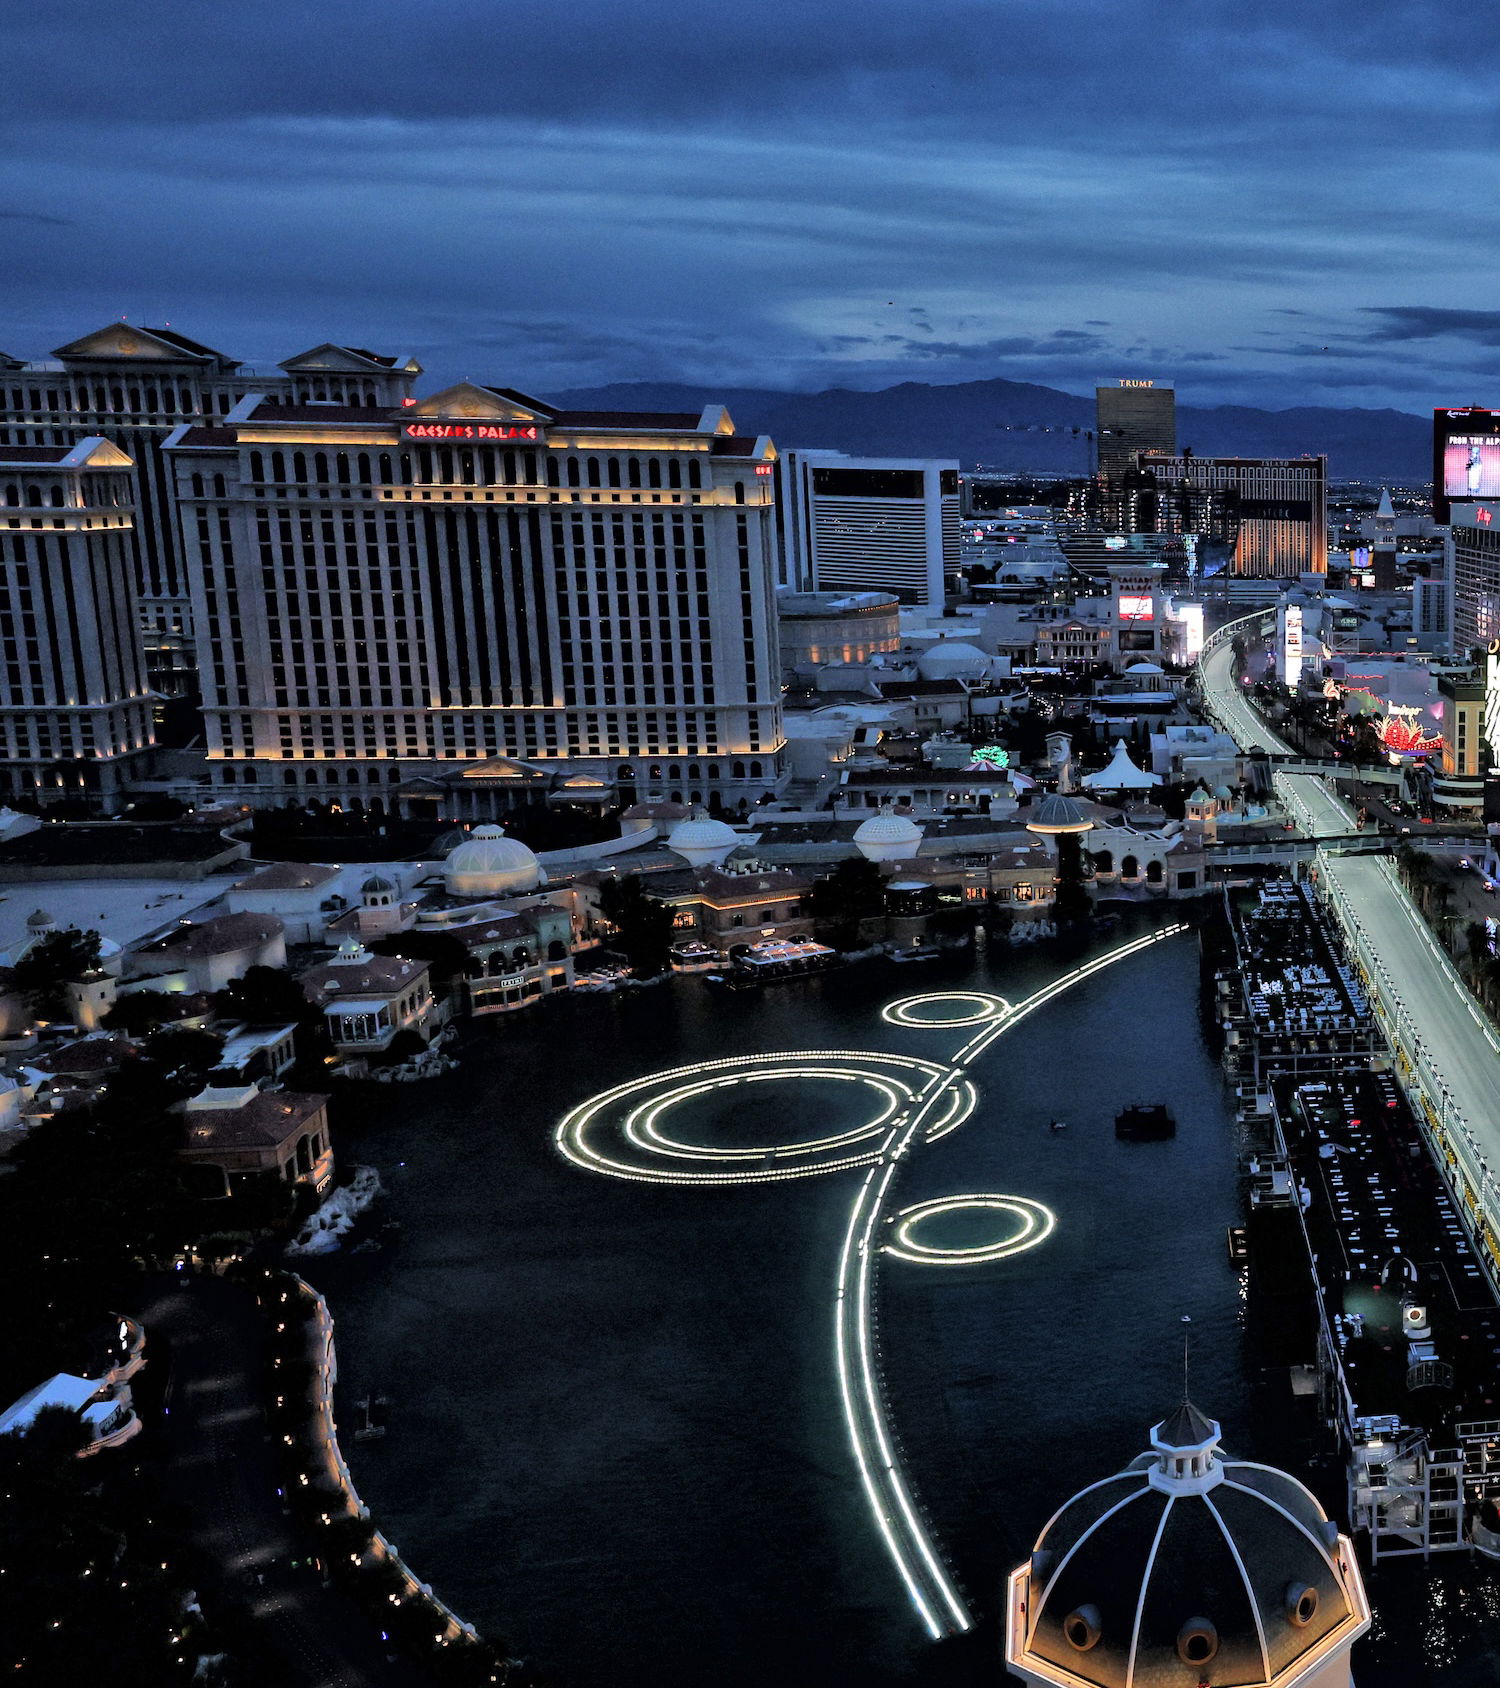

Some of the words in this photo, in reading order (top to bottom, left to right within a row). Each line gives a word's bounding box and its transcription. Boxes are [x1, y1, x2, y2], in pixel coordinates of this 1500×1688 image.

[1119, 379, 1154, 388] TRUMP
[406, 424, 475, 439] CAESARS
[478, 426, 537, 440] PALACE
[1449, 436, 1468, 445] FROM
[1469, 436, 1484, 445] THE
